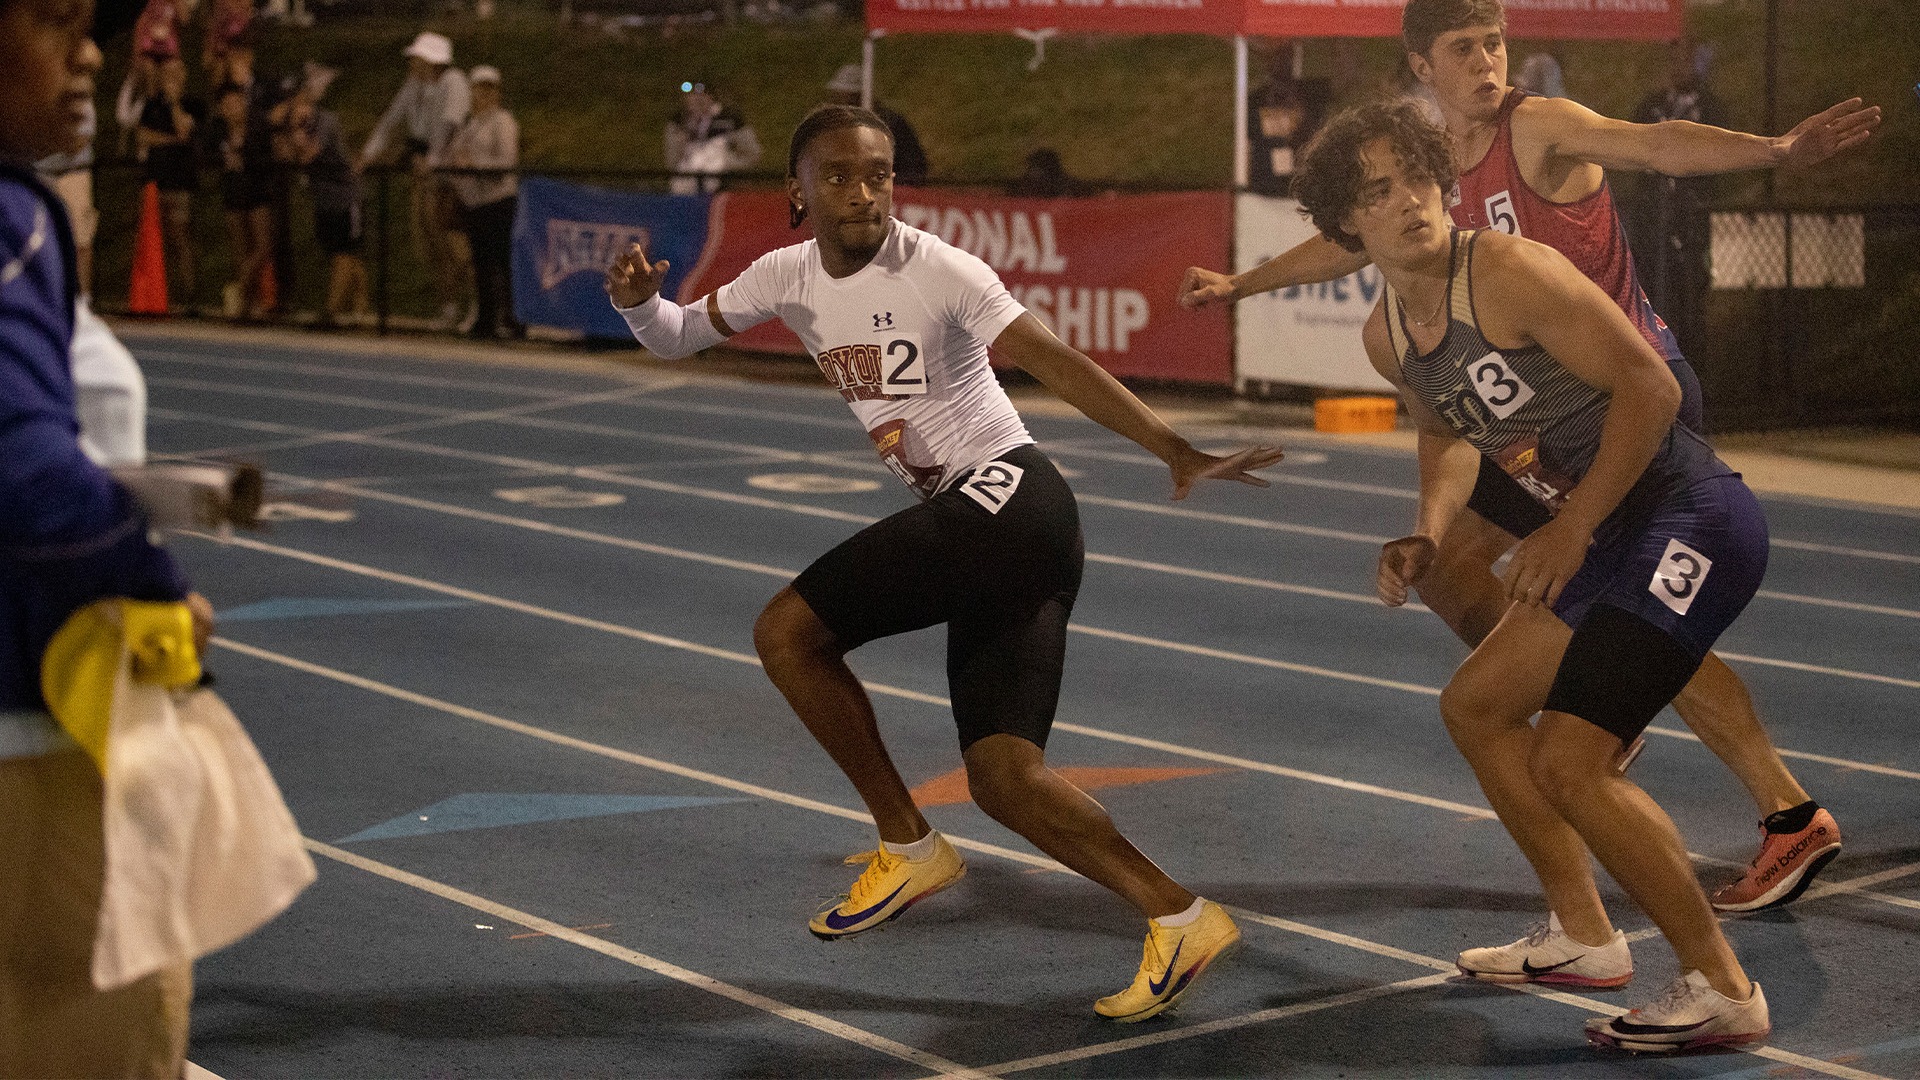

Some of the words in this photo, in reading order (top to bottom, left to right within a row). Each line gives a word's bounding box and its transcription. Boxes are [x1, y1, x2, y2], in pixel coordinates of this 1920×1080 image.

[1489, 196, 1516, 236] 5
[1012, 284, 1150, 353] SHIP
[886, 339, 923, 386] 2
[1476, 362, 1520, 407] 3
[969, 465, 1014, 506] 2
[1661, 551, 1701, 599] 3
[1756, 863, 1779, 887] new
[1778, 826, 1827, 868] balance
